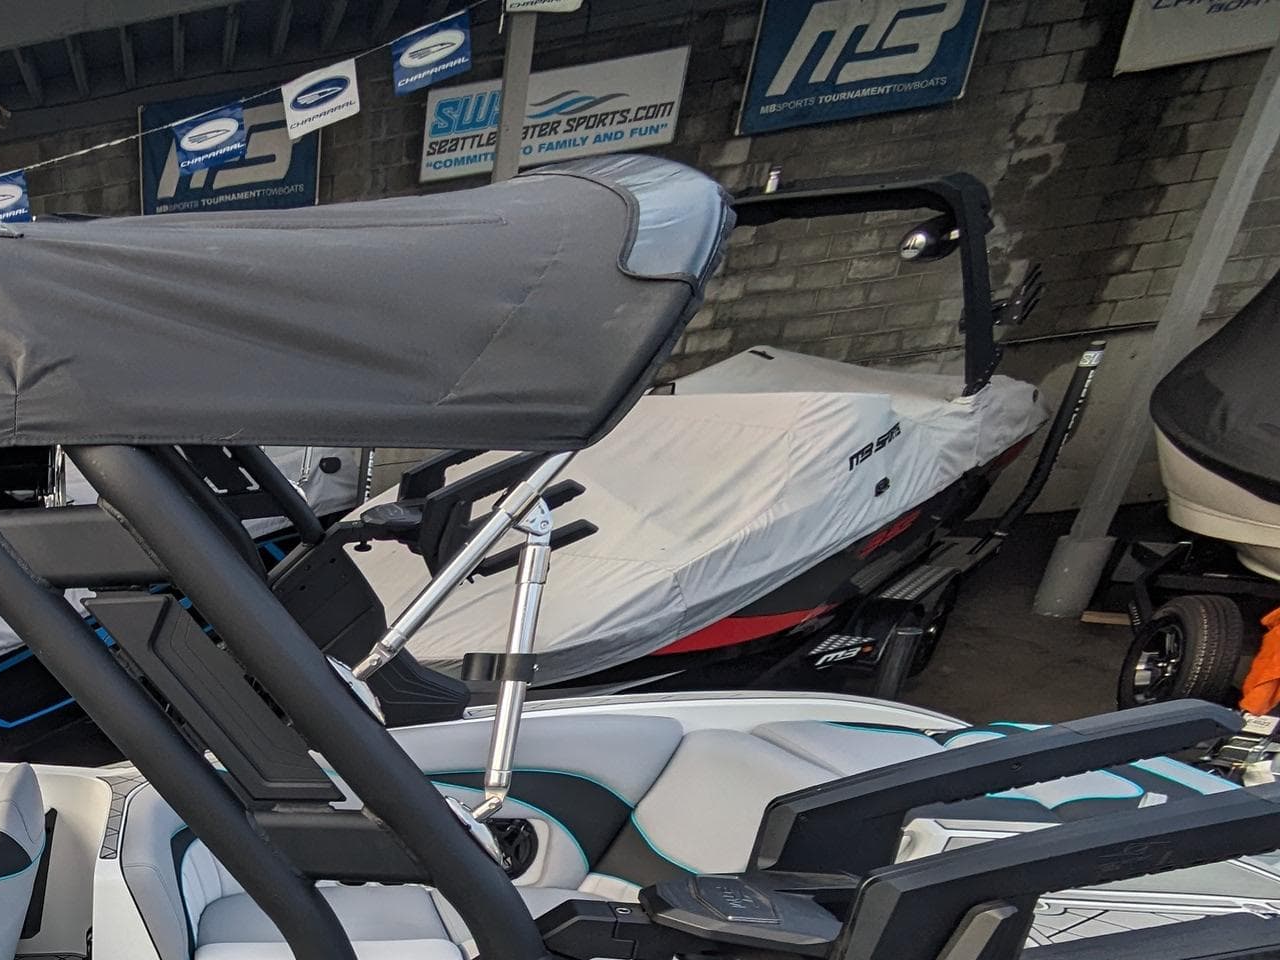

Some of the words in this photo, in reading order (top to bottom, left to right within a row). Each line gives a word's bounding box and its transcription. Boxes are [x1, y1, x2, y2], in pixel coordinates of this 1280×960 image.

[397, 56, 470, 88] CHAPARRAL
[289, 100, 357, 129] CHAPARRAL
[521, 119, 562, 141] ATER
[538, 136, 589, 153] FAMILY
[592, 131, 625, 144] AND
[180, 142, 247, 168] CHAPARRAL
